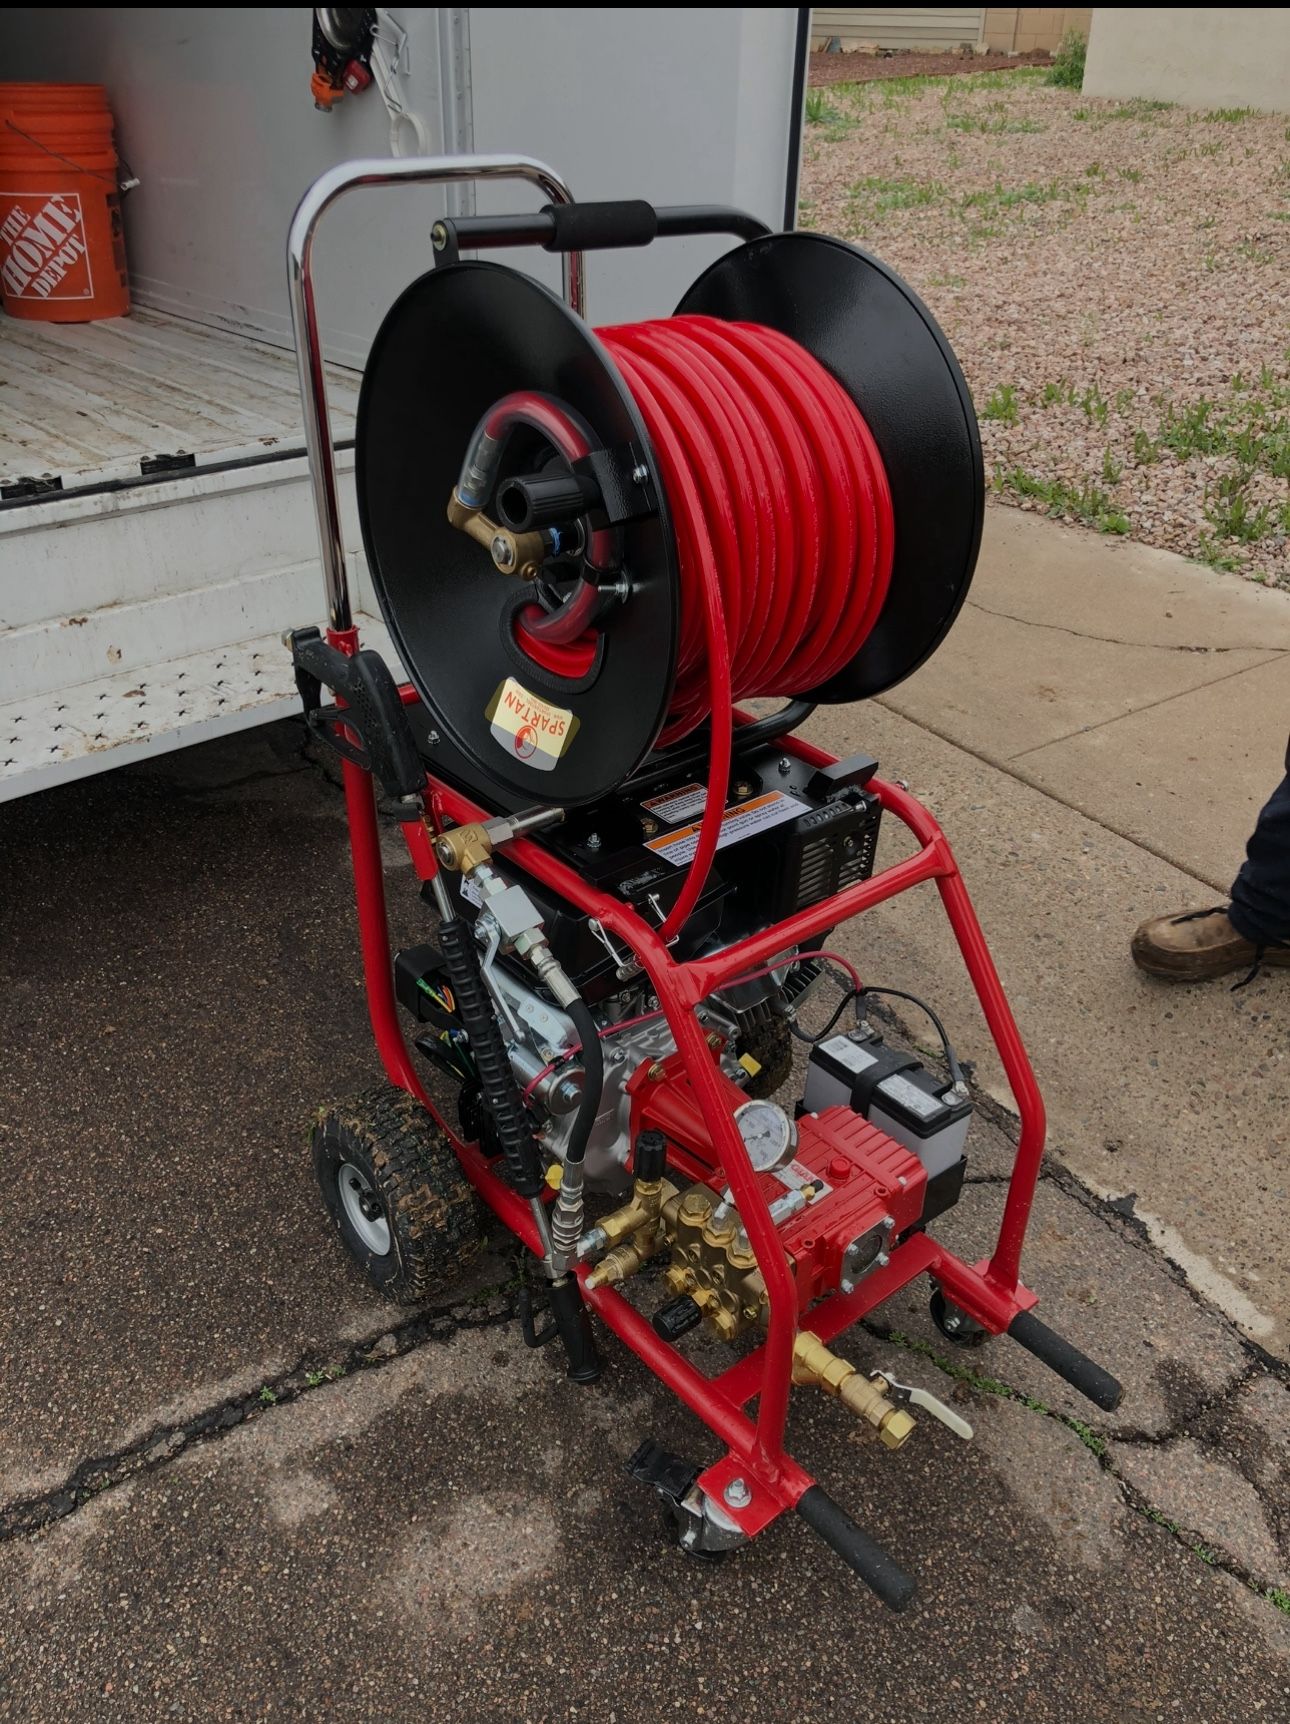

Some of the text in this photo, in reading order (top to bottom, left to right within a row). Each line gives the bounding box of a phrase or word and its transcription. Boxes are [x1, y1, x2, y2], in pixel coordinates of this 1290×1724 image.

[0, 205, 31, 247] THE
[1, 194, 82, 296] HOME
[31, 233, 86, 298] DEPOT
[504, 691, 566, 736] SPARTAN
